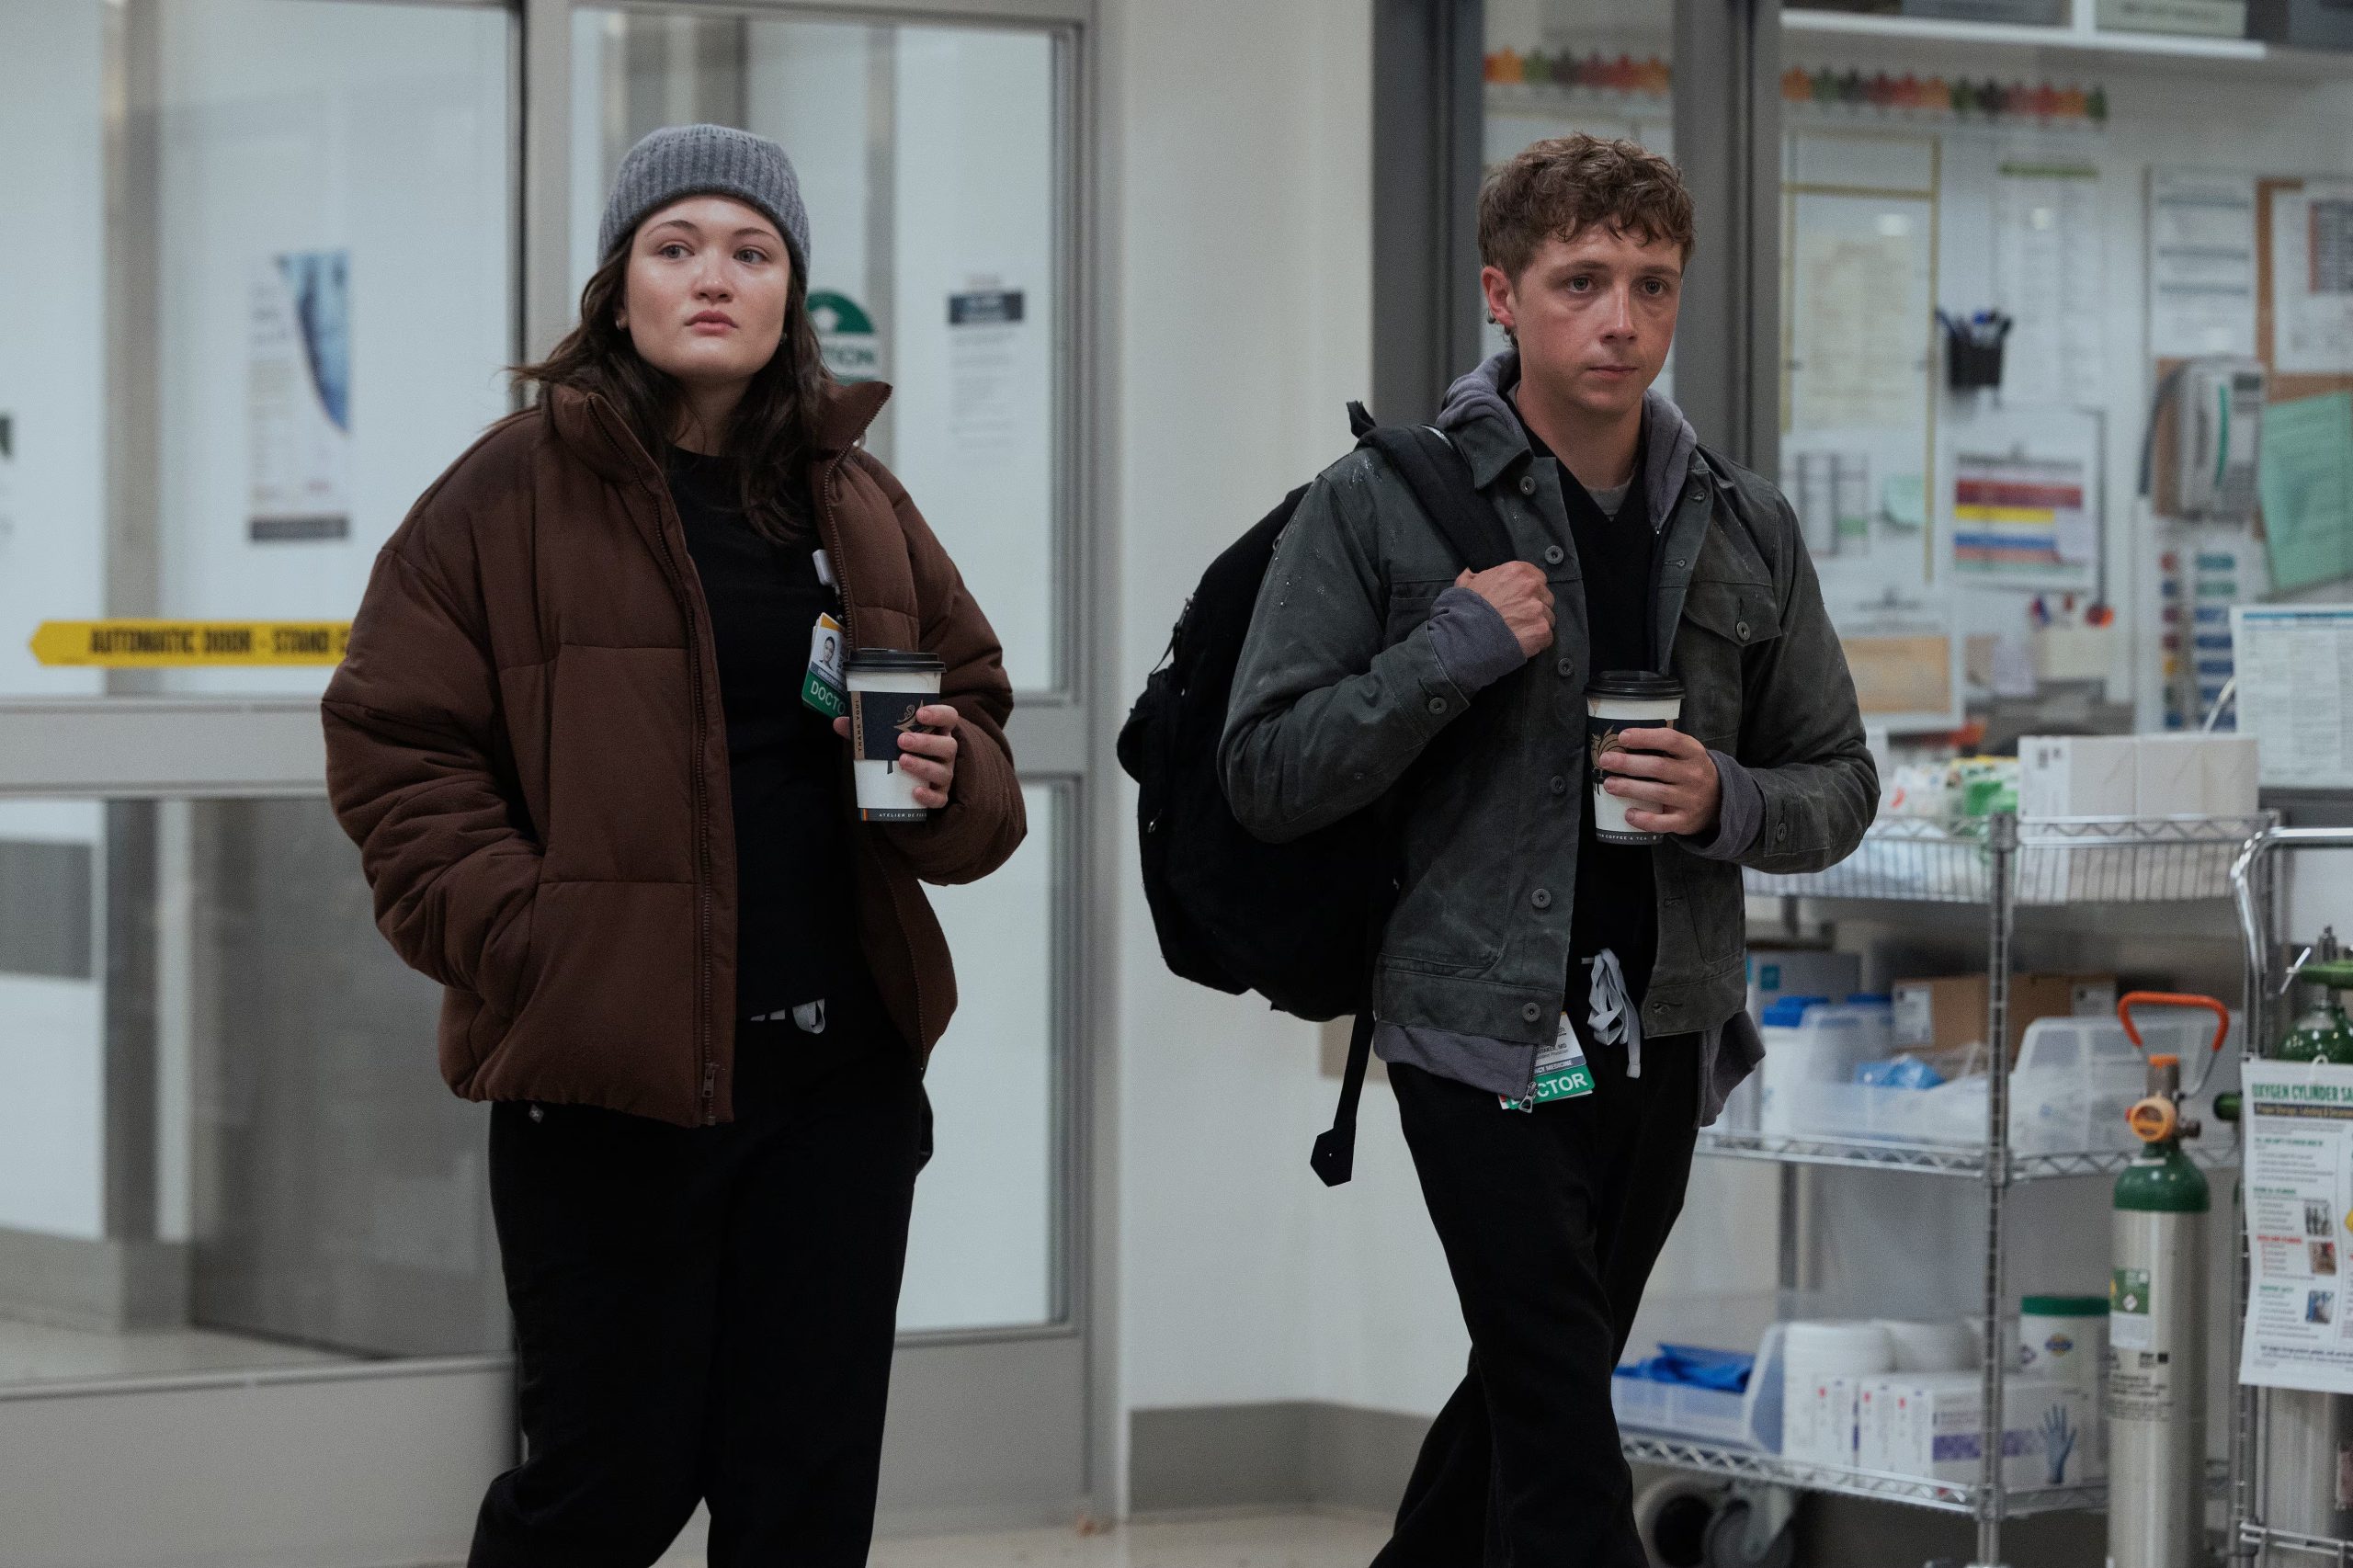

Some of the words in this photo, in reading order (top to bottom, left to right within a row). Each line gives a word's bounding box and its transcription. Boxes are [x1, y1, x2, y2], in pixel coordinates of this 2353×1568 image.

[90, 628, 195, 653] AUTOMATIC
[202, 629, 252, 653] DOOR
[272, 629, 330, 653] STAND
[810, 680, 846, 715] DOCTO
[1522, 1073, 1589, 1100] CTOR
[2251, 1084, 2289, 1100] OXYGEN
[2292, 1085, 2339, 1102] CYLINDER
